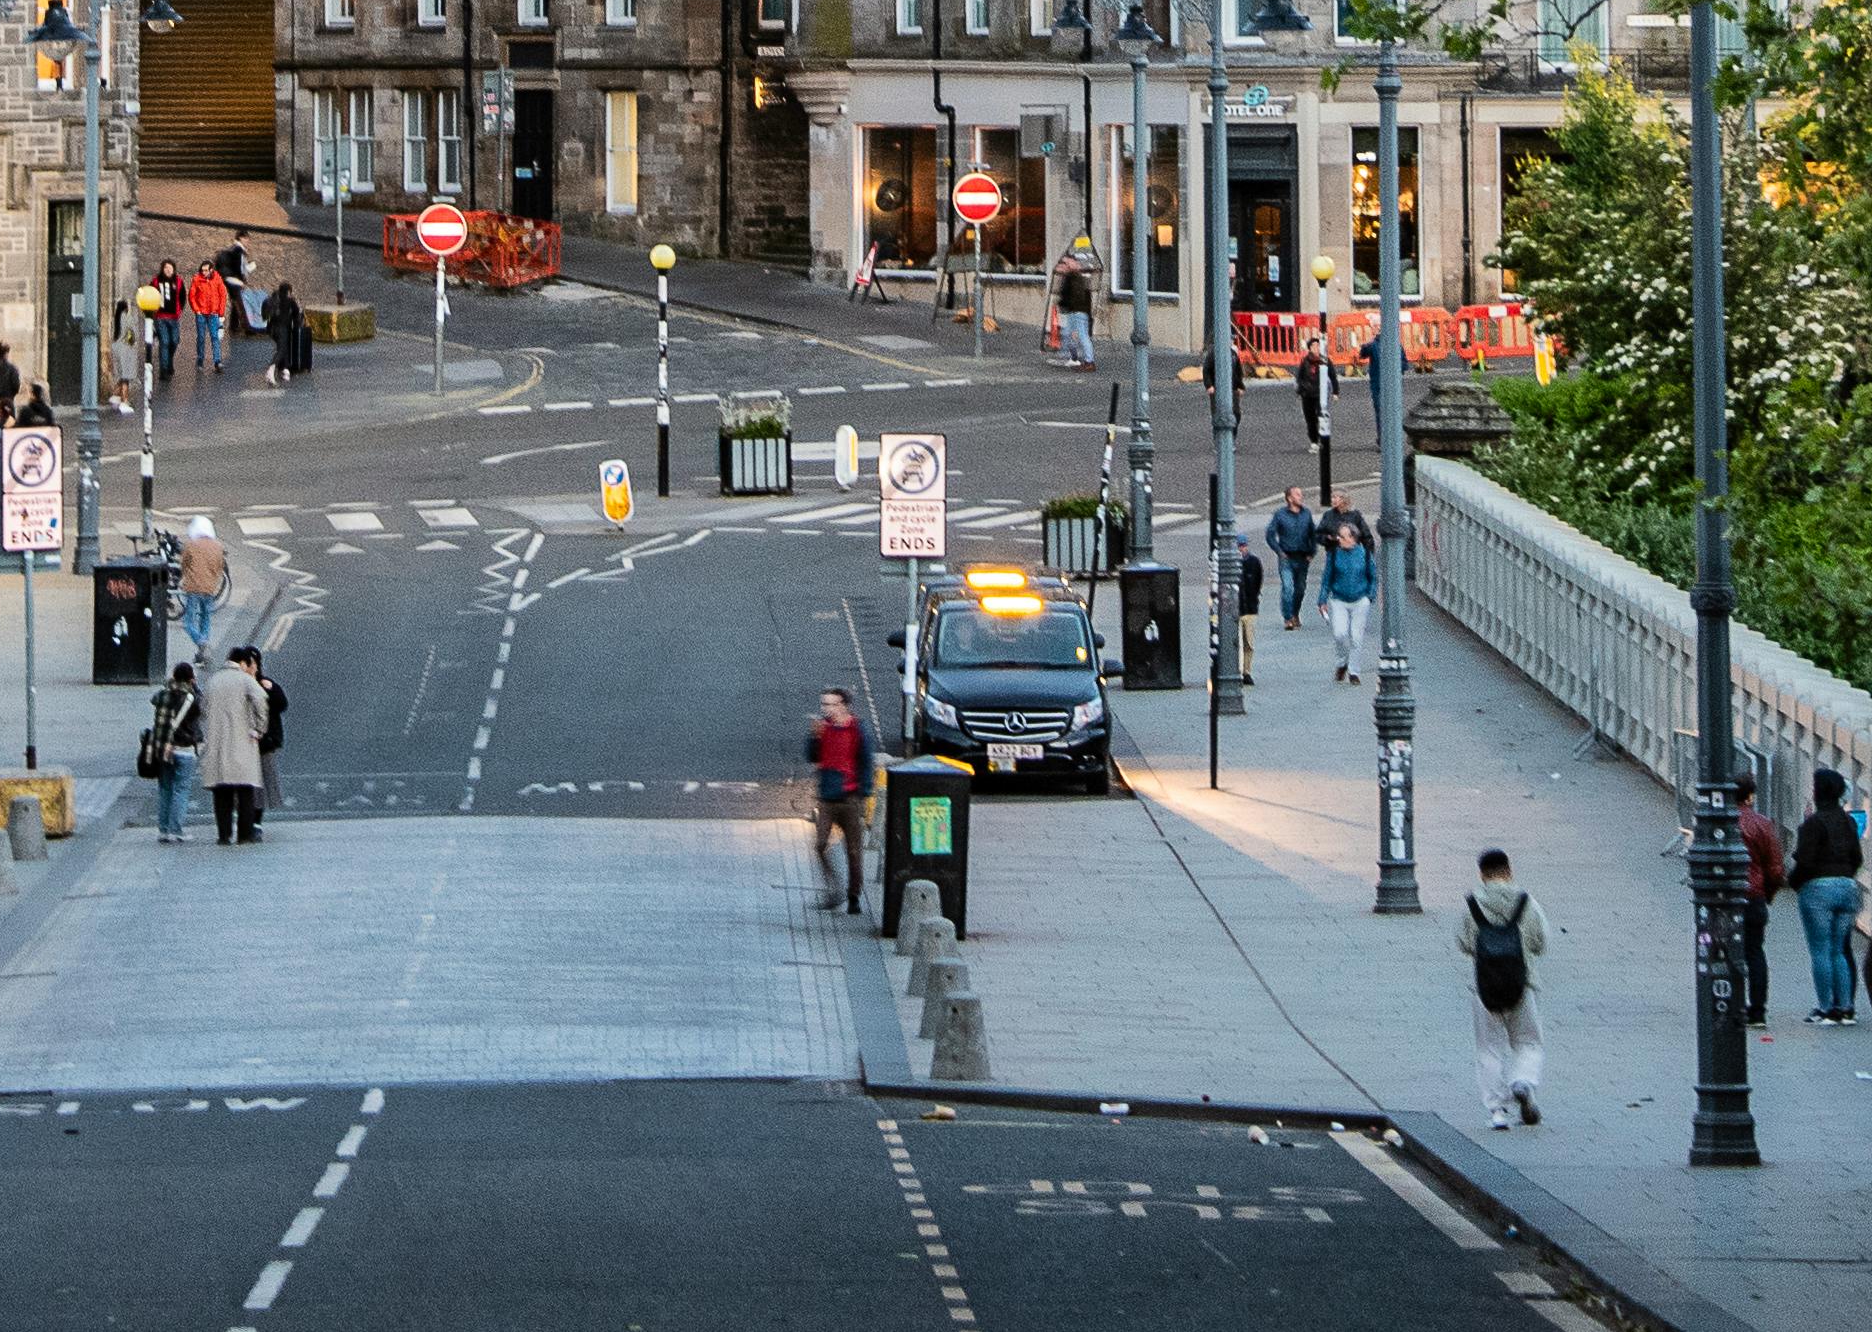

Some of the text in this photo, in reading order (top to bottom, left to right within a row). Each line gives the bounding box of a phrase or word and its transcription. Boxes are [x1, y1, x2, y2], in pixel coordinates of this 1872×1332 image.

[886, 503, 940, 513] Pedestrian
[889, 515, 937, 525] and cycle
[889, 538, 936, 550] ENDS
